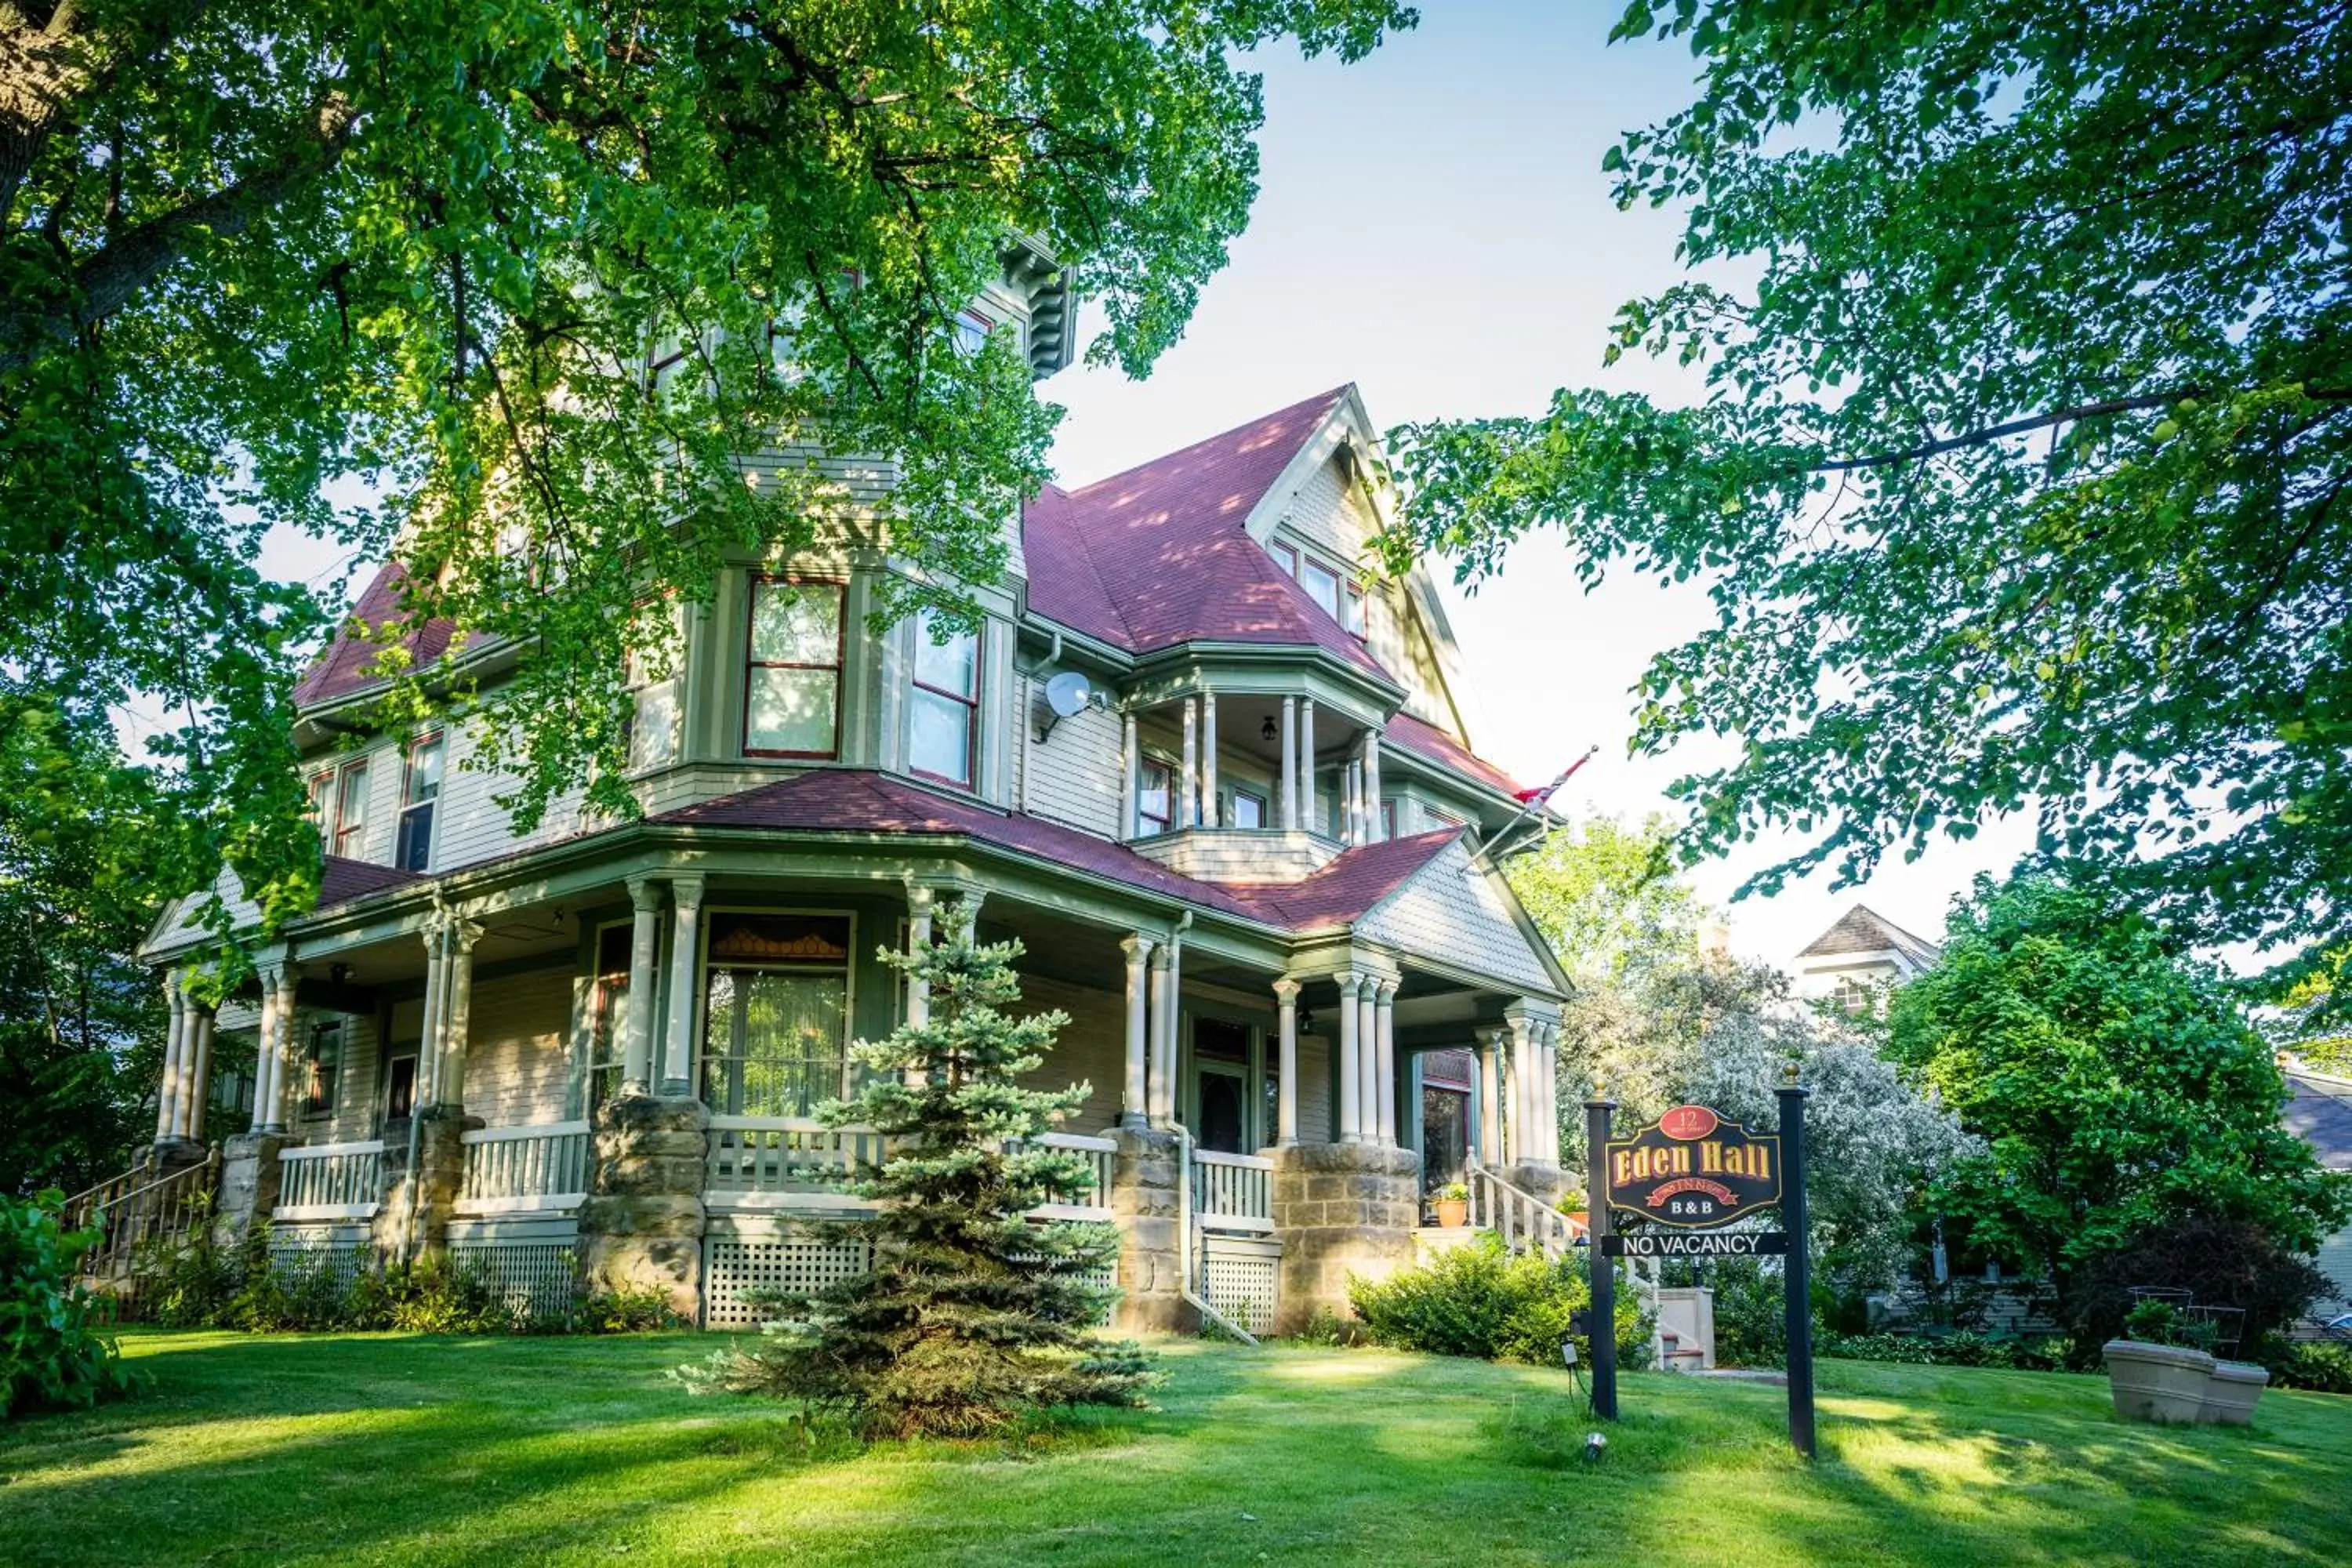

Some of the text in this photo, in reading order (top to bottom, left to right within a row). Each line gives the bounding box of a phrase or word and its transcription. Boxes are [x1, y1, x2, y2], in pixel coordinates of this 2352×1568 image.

[1680, 1111, 1697, 1127] 12
[1613, 1140, 1771, 1185] Eden Hall
[1624, 1235, 1760, 1254] NO VACANCY
